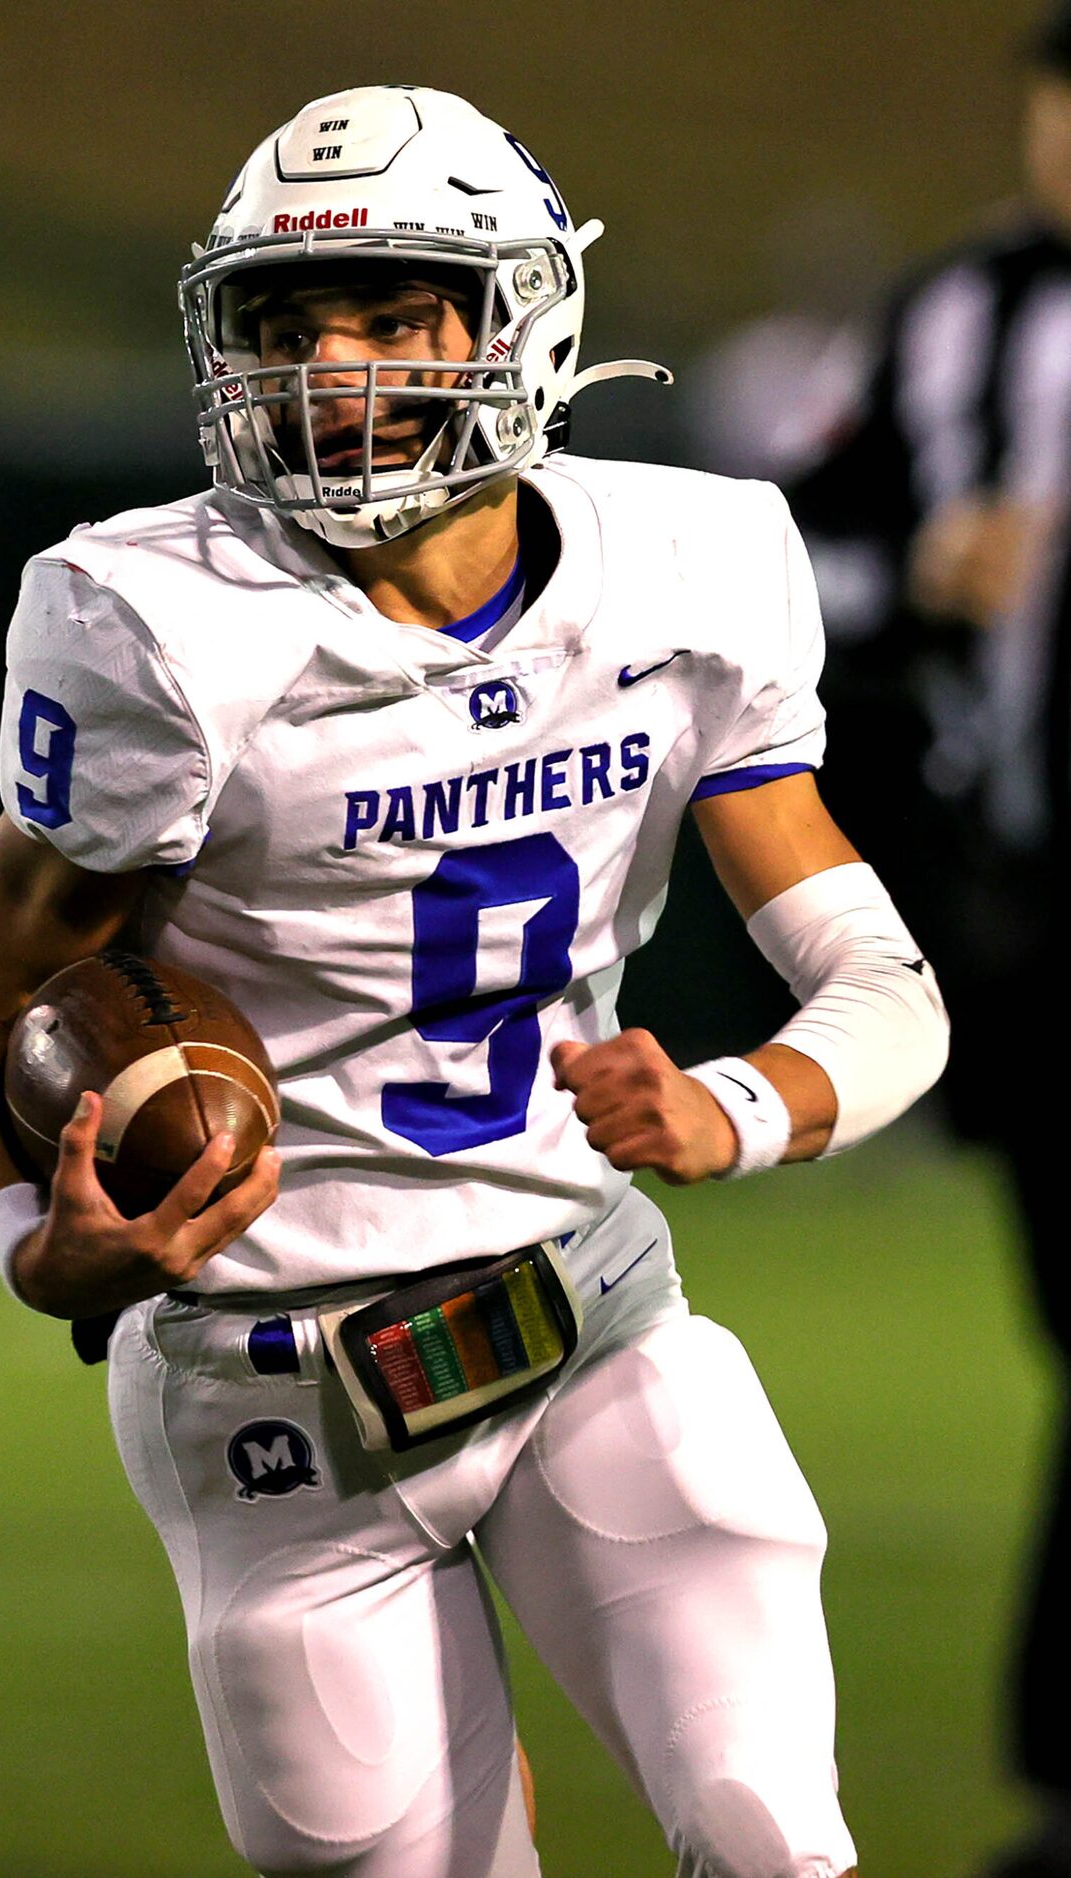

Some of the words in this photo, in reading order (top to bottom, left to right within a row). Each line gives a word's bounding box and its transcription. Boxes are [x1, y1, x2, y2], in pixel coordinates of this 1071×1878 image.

[319, 119, 350, 133] WIN
[312, 145, 343, 162] WIN
[503, 131, 568, 232] 9
[273, 208, 368, 234] Riddell
[470, 211, 498, 233] WIN
[478, 690, 509, 720] M
[17, 689, 77, 830] 9
[342, 731, 651, 851] PANTHERS
[381, 832, 581, 1158] 9
[241, 1434, 297, 1480] M
